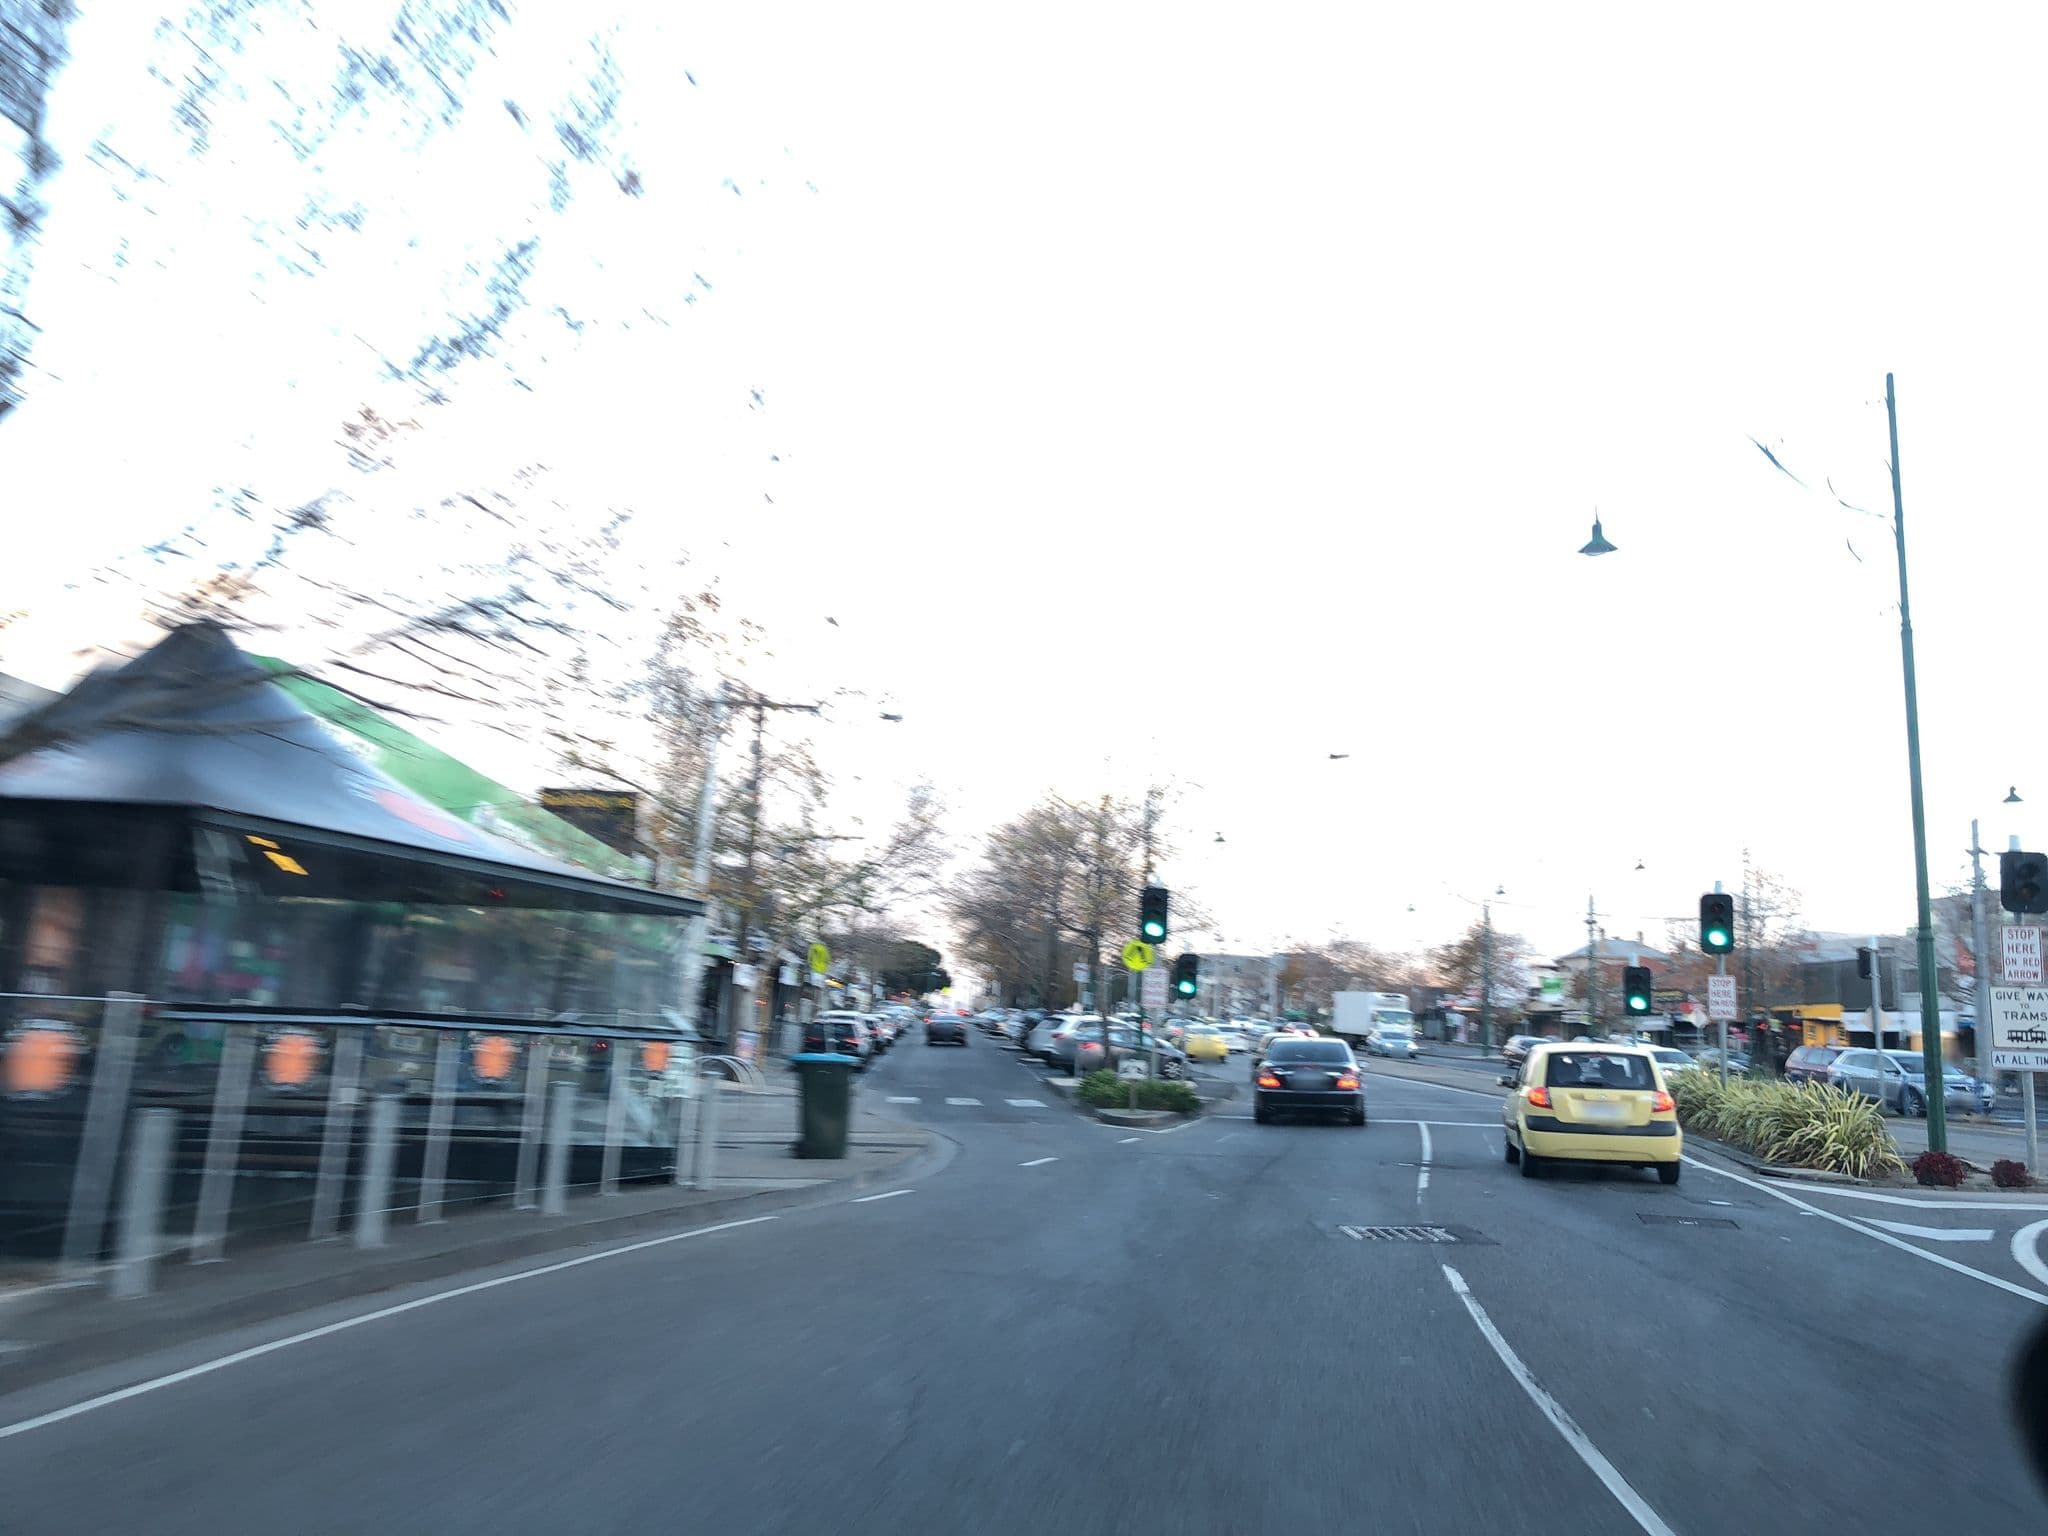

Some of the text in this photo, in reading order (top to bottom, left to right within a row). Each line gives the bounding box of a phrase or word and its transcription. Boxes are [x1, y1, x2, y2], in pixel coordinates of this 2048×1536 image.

[2007, 928, 2034, 940] STOP
[2007, 943, 2036, 954] HERE
[2005, 957, 2040, 967] ON RED
[2007, 969, 2039, 980] ARROW
[1995, 991, 2020, 1001] GIVE
[2002, 1010, 2048, 1021] TRAMS
[1994, 1054, 2006, 1064] AT
[2011, 1055, 2030, 1065] ALL
